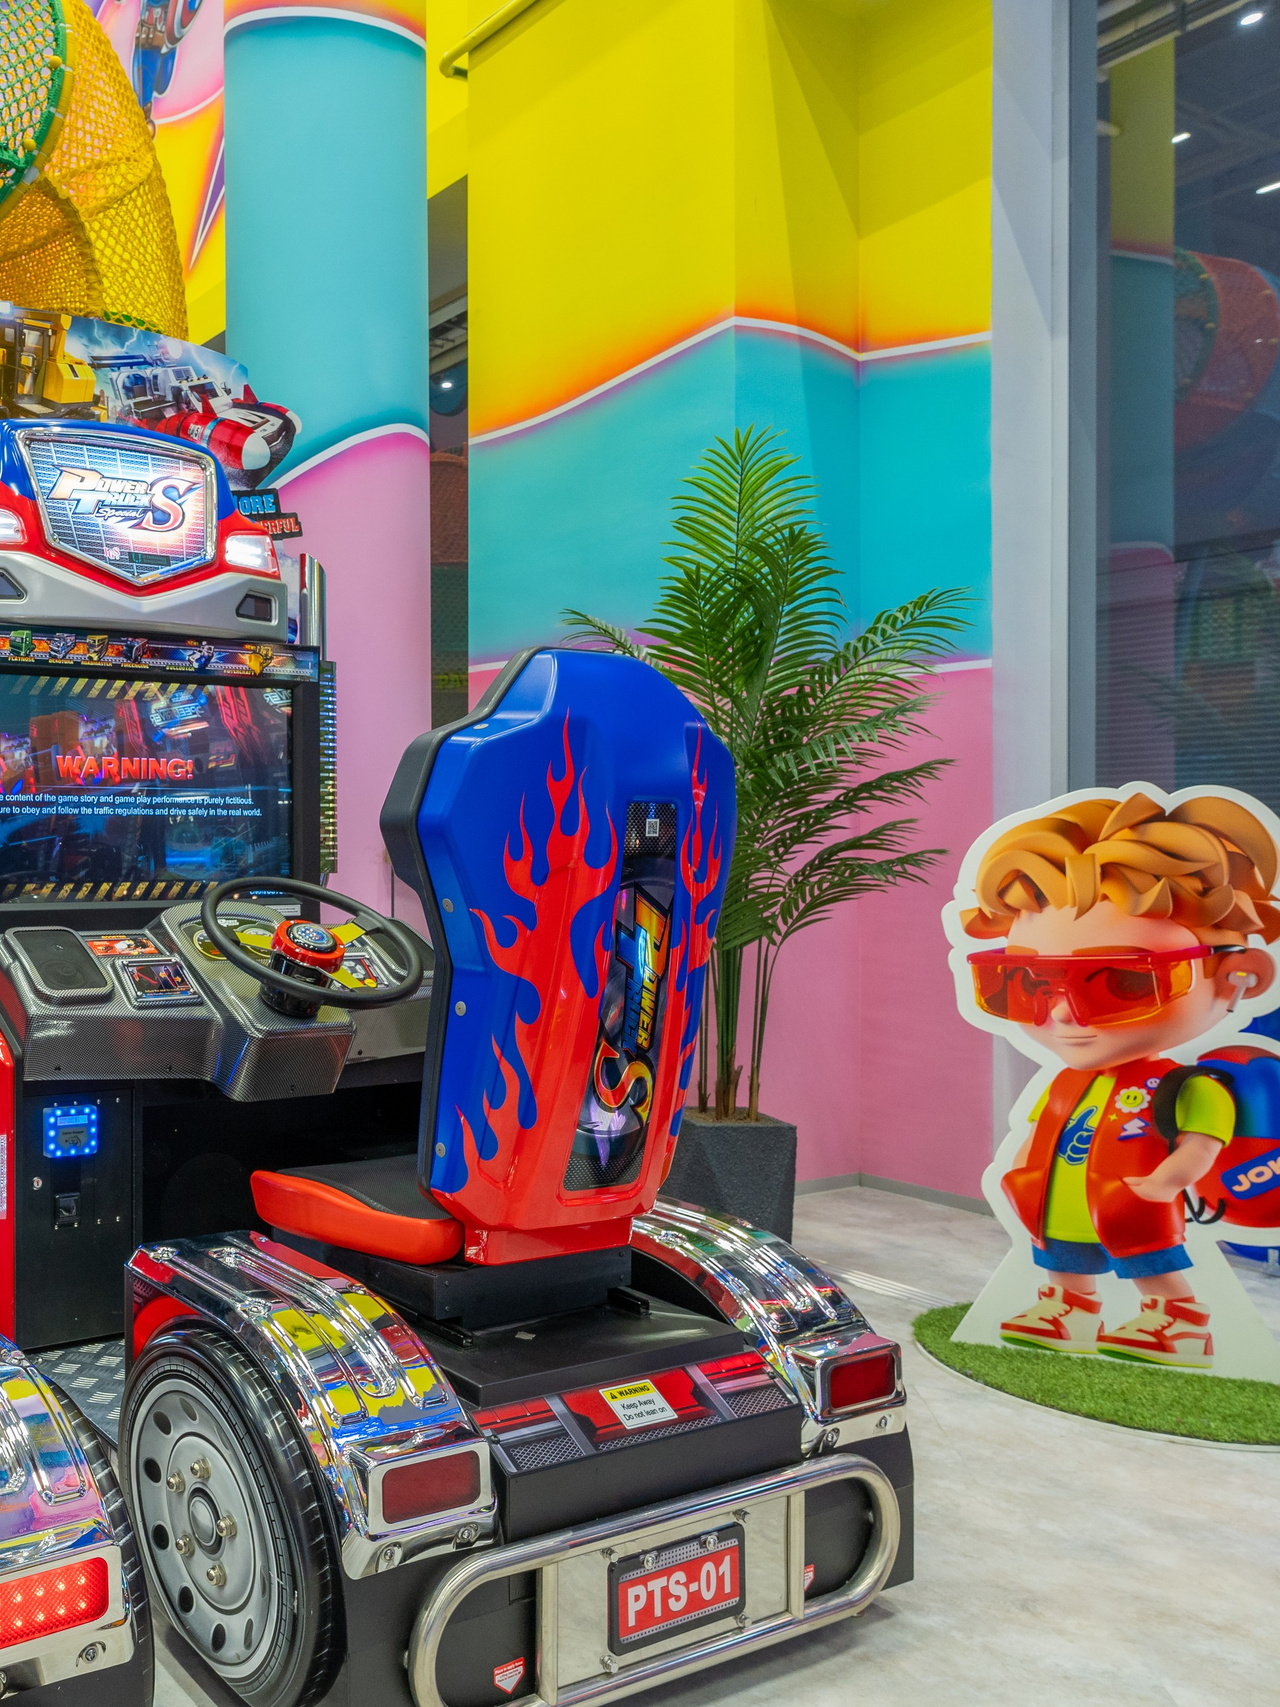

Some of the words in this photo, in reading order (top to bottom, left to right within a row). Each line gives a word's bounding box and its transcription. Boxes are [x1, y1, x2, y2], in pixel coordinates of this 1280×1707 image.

[48, 465, 149, 499] POWER
[70, 489, 154, 516] TRUCK
[95, 508, 144, 520] Special
[232, 494, 276, 515] ORE
[56, 755, 194, 780] WARNING!
[5, 793, 33, 802] content
[35, 793, 43, 802] of
[44, 794, 56, 802] the
[58, 796, 79, 804] game
[80, 795, 97, 804] story
[100, 795, 114, 803] and
[115, 797, 135, 805] game
[136, 796, 151, 805] play
[152, 796, 195, 805] performance
[196, 796, 203, 804] is
[204, 797, 225, 805] purely
[225, 796, 254, 805] fictitious.
[12, 806, 20, 814] to
[21, 806, 40, 816] obey
[41, 806, 56, 814] and
[58, 806, 80, 815] follow
[80, 806, 92, 815] the
[93, 806, 114, 815] traffic
[115, 807, 154, 817] regulations
[155, 807, 168, 816] and
[169, 807, 187, 816] drive
[187, 808, 208, 817] safely
[209, 808, 216, 816] in
[217, 808, 228, 816] the
[228, 808, 242, 816] real
[242, 808, 262, 817] world.
[635, 892, 670, 1050] POWER
[616, 923, 647, 1057] TRUCK
[593, 1040, 653, 1127] S
[617, 1385, 650, 1397] WARNING
[620, 1402, 638, 1410] Keep
[638, 1398, 656, 1406] Away
[623, 1413, 634, 1421] Do
[635, 1411, 644, 1419] not
[627, 1555, 731, 1627] PTS-01
